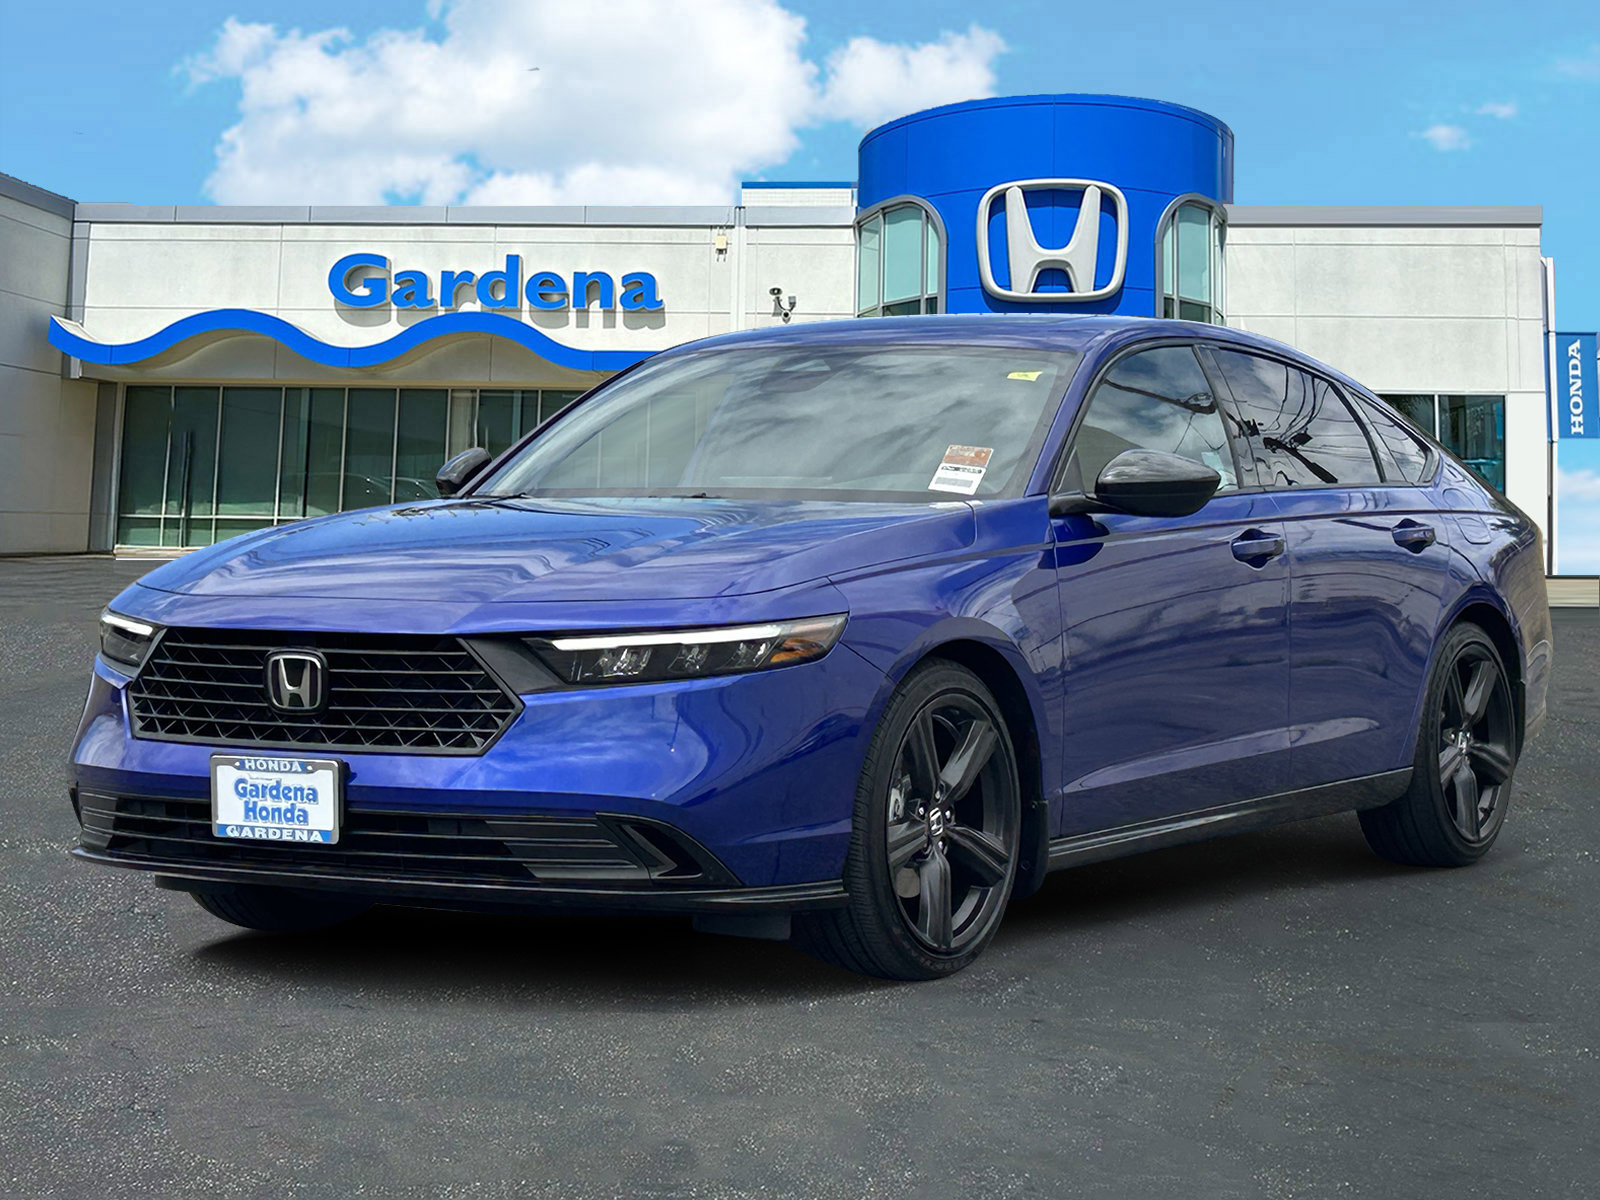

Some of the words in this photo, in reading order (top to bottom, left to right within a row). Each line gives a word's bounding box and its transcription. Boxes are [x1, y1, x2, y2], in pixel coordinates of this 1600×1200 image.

[328, 253, 664, 311] Gardena
[1568, 339, 1584, 435] HONDA
[244, 759, 302, 772] HONDA
[234, 776, 319, 804] Gardena
[243, 800, 309, 825] Honda
[225, 826, 324, 842] GARDENA
